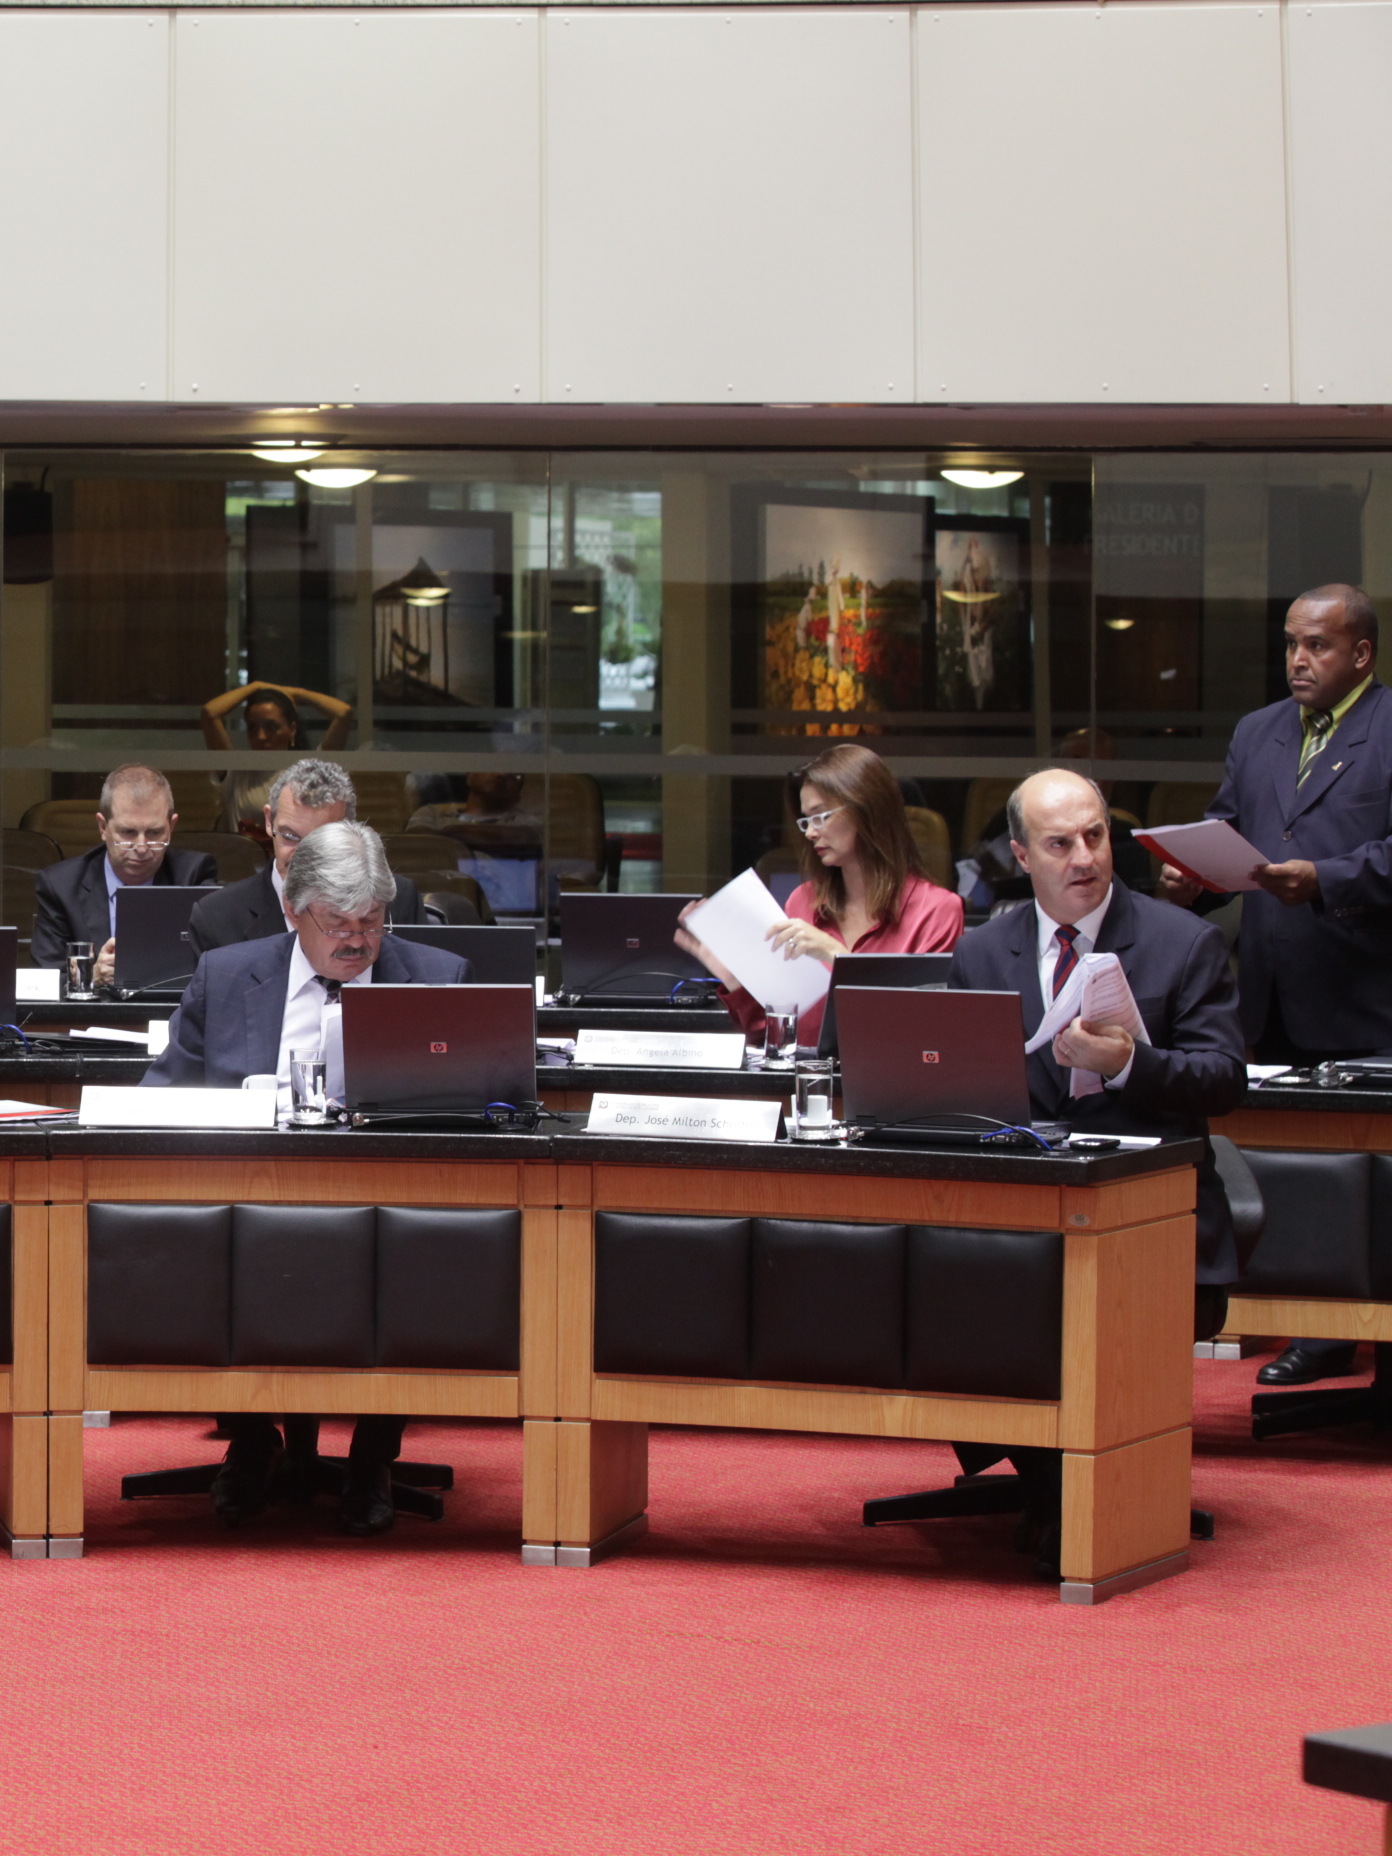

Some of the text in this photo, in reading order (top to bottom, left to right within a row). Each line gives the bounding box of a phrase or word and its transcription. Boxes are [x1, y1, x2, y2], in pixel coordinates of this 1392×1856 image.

[671, 1048, 704, 1057] Albino
[615, 1113, 640, 1126] Dep.
[644, 1114, 670, 1126] José
[671, 1116, 707, 1128] Milton
